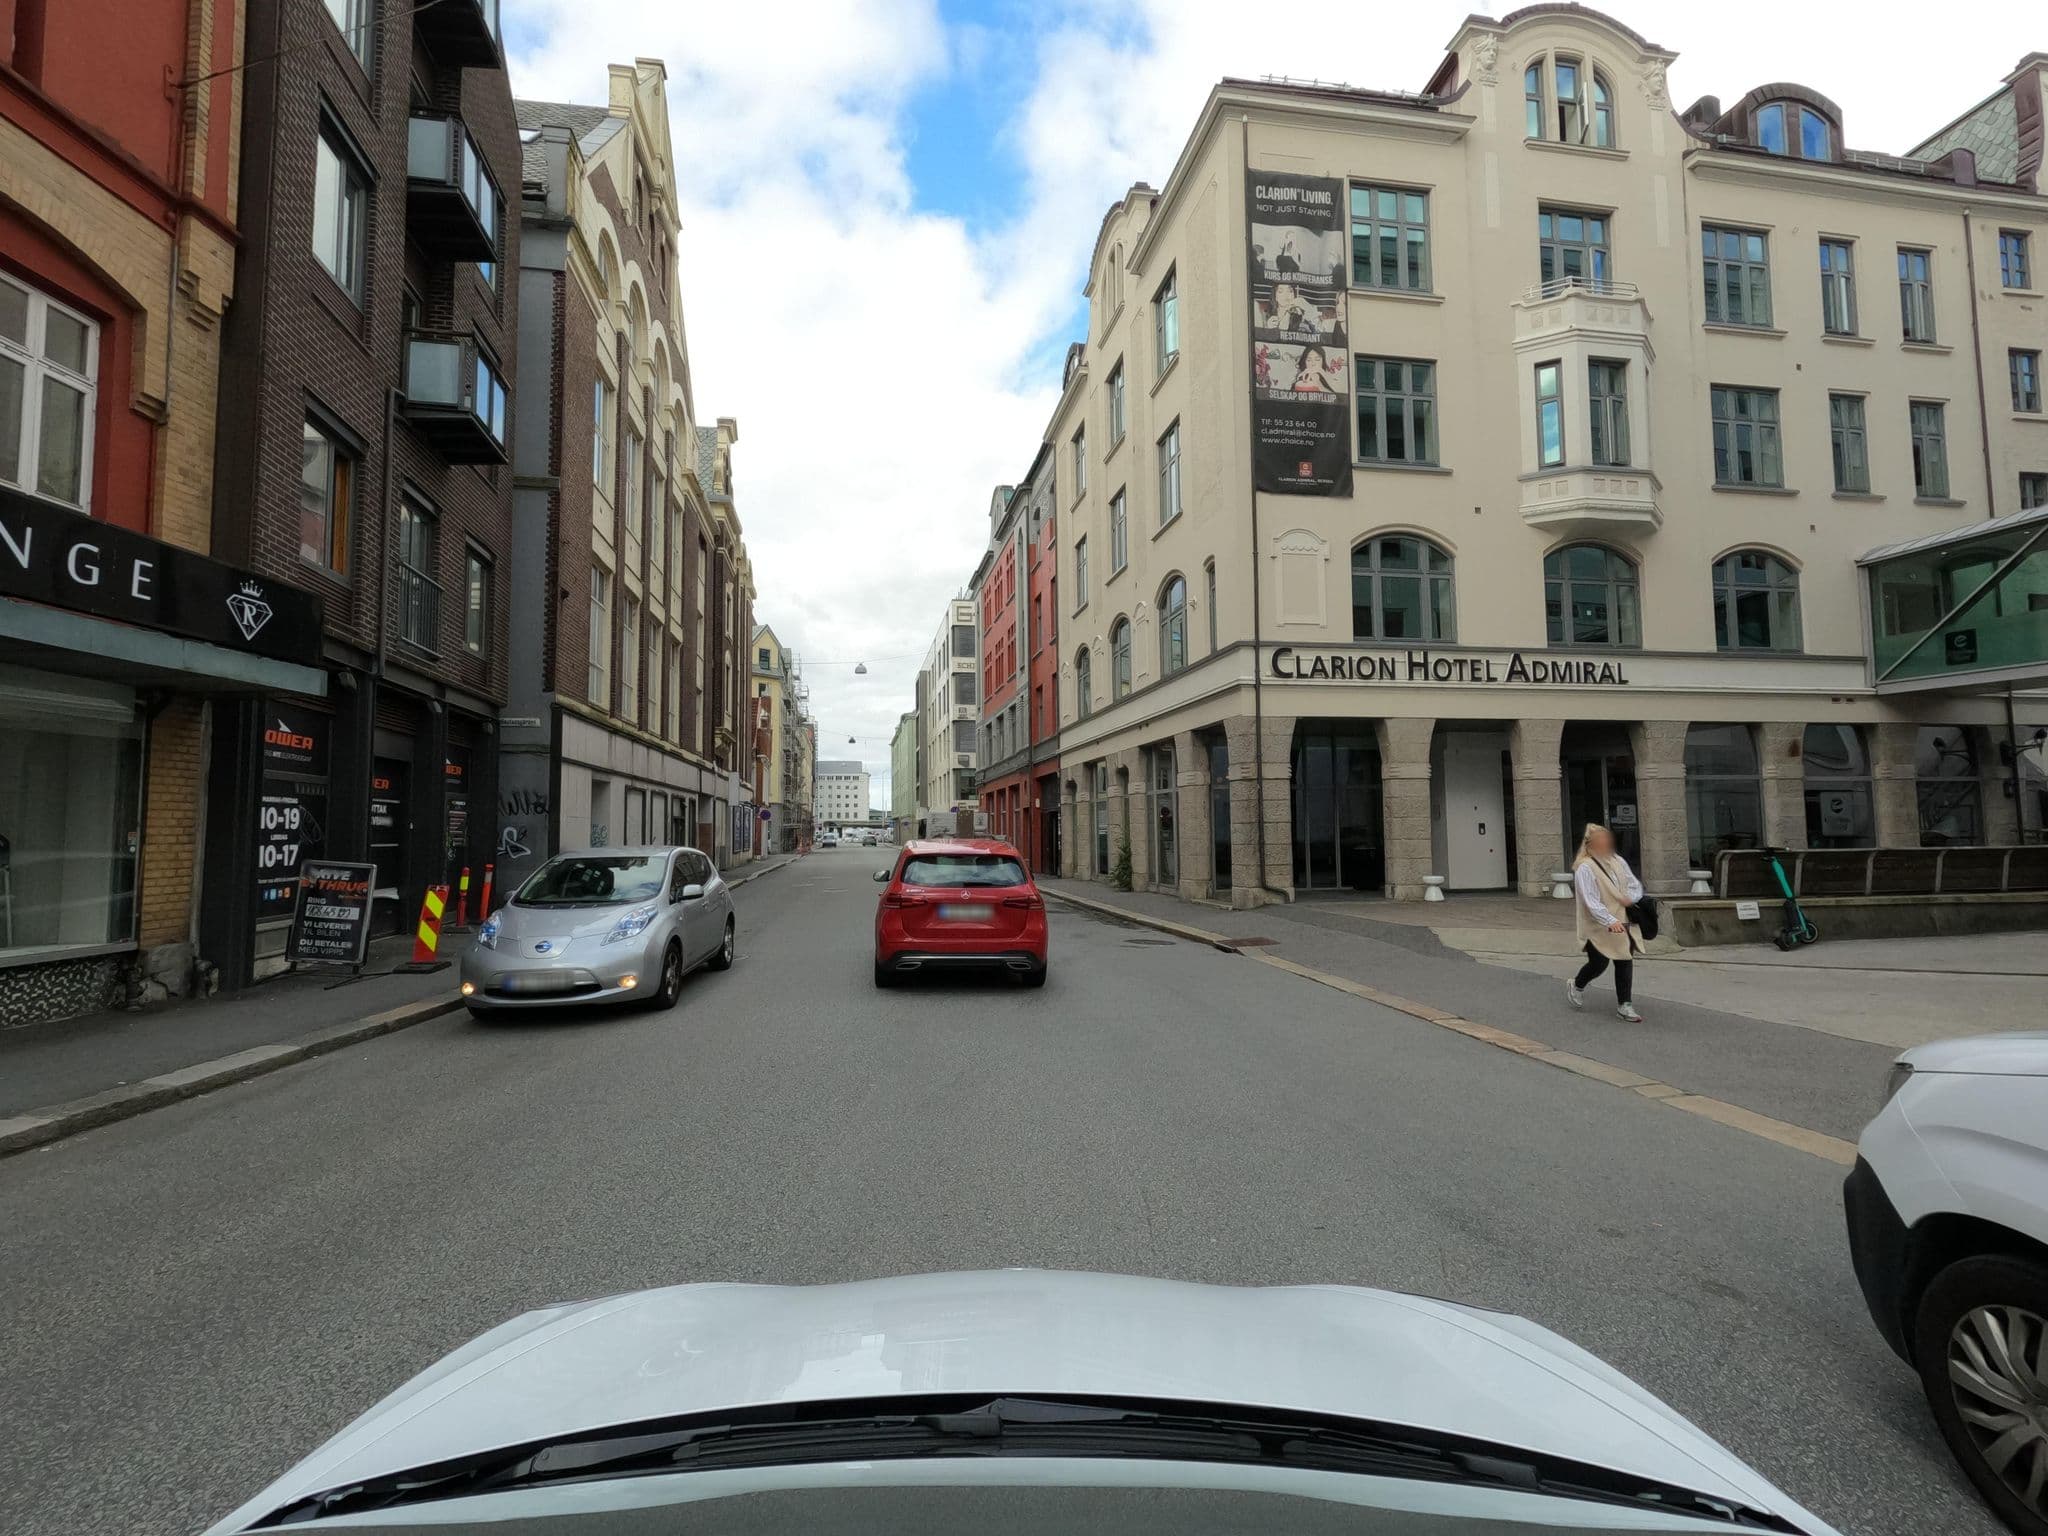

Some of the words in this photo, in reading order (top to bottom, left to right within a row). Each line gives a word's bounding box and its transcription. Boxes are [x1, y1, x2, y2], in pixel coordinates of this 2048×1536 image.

[1256, 185, 1297, 201] CLARION
[1256, 204, 1274, 212] NOT
[1275, 205, 1297, 213] JUST
[1264, 270, 1281, 281] KURS
[1281, 272, 1291, 281] OG
[1280, 331, 1321, 343] RESTAURANT
[1269, 389, 1298, 401] SELSKAP
[1298, 392, 1307, 401] OG
[1308, 392, 1337, 403] BRYLLUP
[1261, 437, 1315, 446] www.choice.no
[1271, 648, 1396, 680] CLARION
[1406, 650, 1498, 683] HOTEL
[1504, 652, 1630, 685] ADMIRAL
[260, 807, 300, 830] 10-19
[258, 844, 299, 868] 10-17
[307, 897, 327, 905] RING
[316, 929, 341, 937] BILEN
[300, 938, 313, 946] DU
[298, 946, 318, 954] MED
[320, 947, 344, 956] VIPPS
